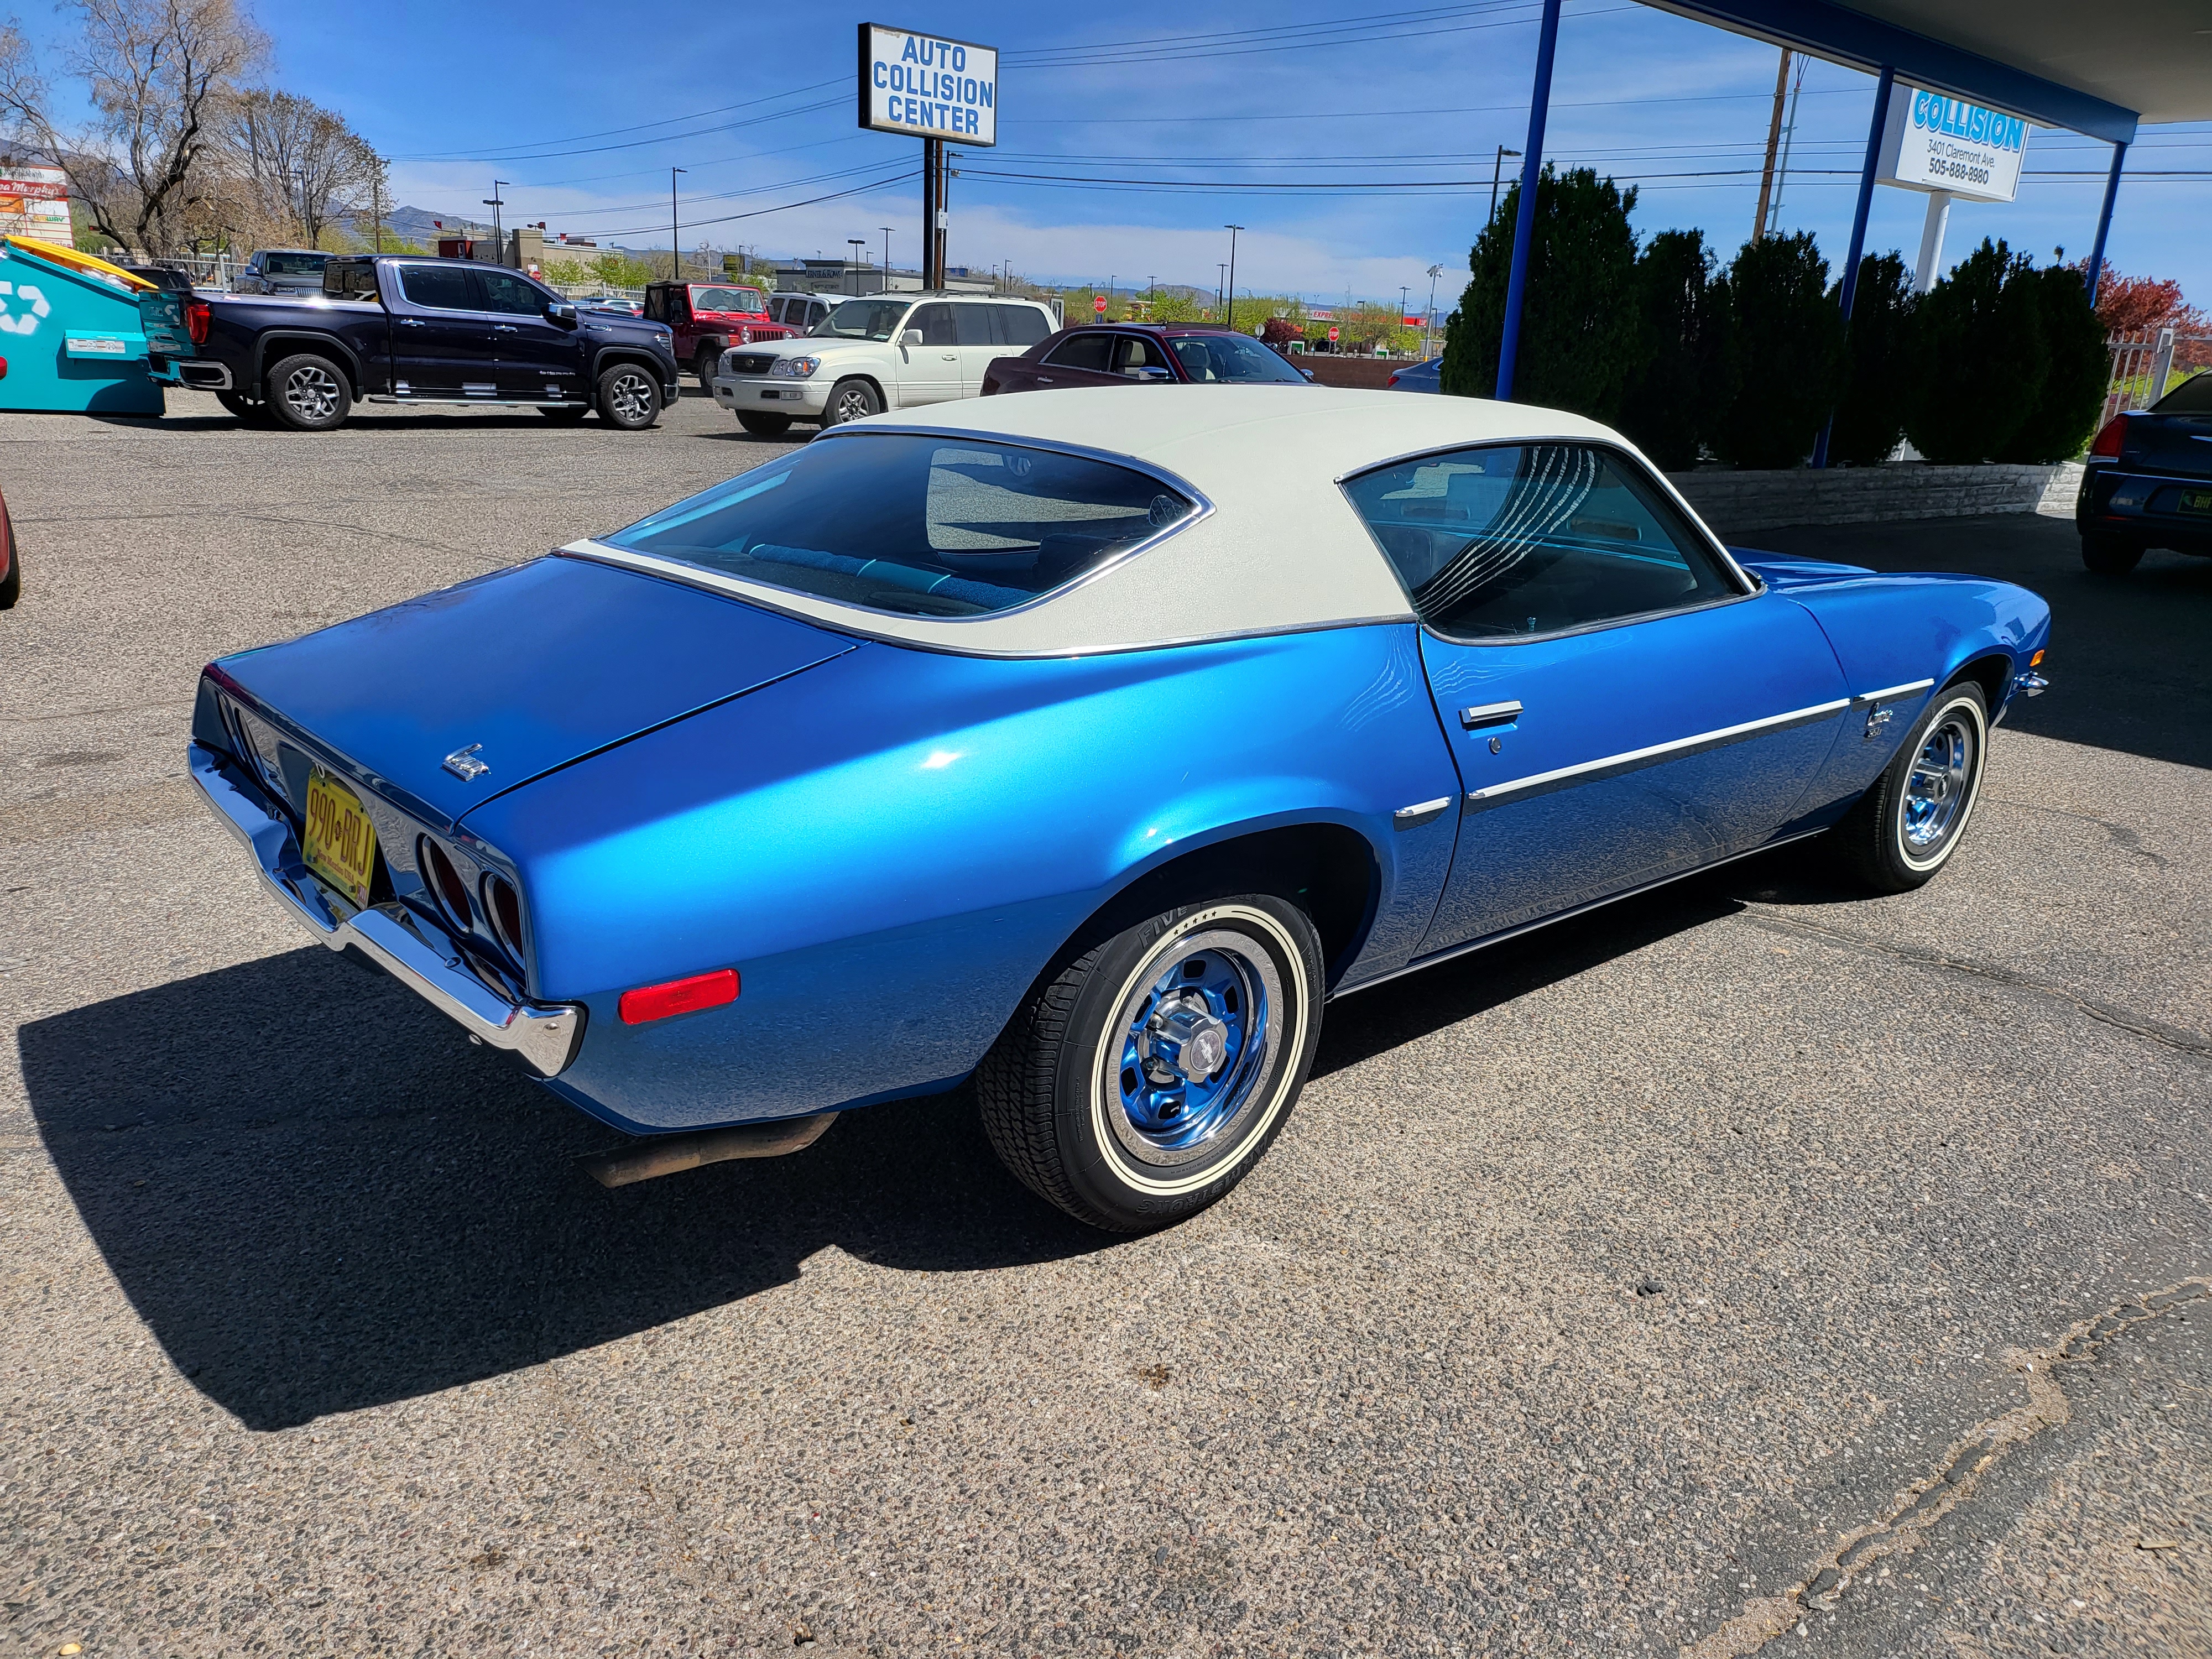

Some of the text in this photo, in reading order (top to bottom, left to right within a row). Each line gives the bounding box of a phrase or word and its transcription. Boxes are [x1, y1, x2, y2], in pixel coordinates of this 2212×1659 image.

[901, 36, 966, 72] AUTO
[873, 61, 993, 108] COLLISION
[888, 95, 979, 135] CENTER
[1913, 90, 2026, 153] COLLISION
[1927, 139, 1995, 168] 3401 Claremont Ave.
[1928, 157, 1989, 185] 505-888-8980
[327, 855, 343, 876] Mexico
[344, 868, 354, 885] USA
